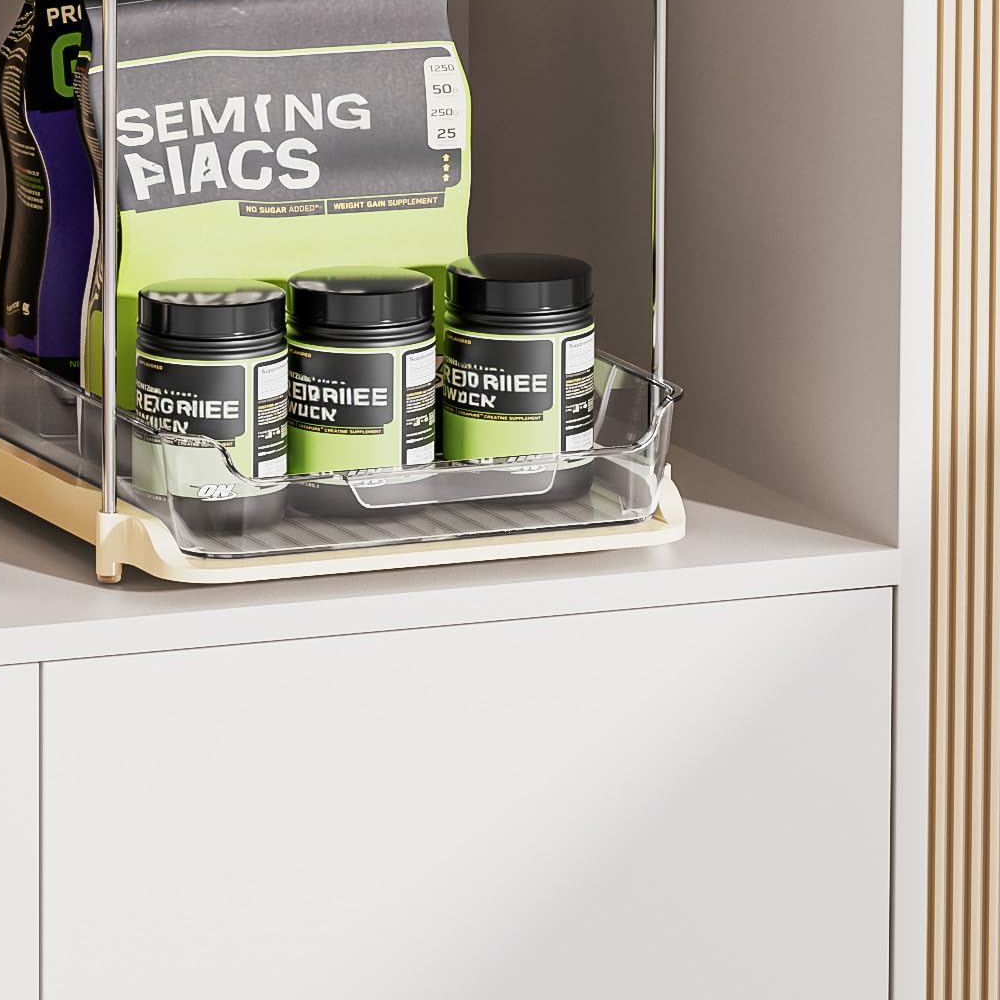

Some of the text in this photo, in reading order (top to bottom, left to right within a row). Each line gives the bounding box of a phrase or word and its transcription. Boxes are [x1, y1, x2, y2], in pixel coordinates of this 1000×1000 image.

[429, 63, 455, 73] 1250
[437, 127, 456, 139] 25
[333, 196, 439, 211] WEIGHT GAIN SUPPLEMENT
[245, 205, 257, 214] NO
[259, 206, 287, 214] SUGAR
